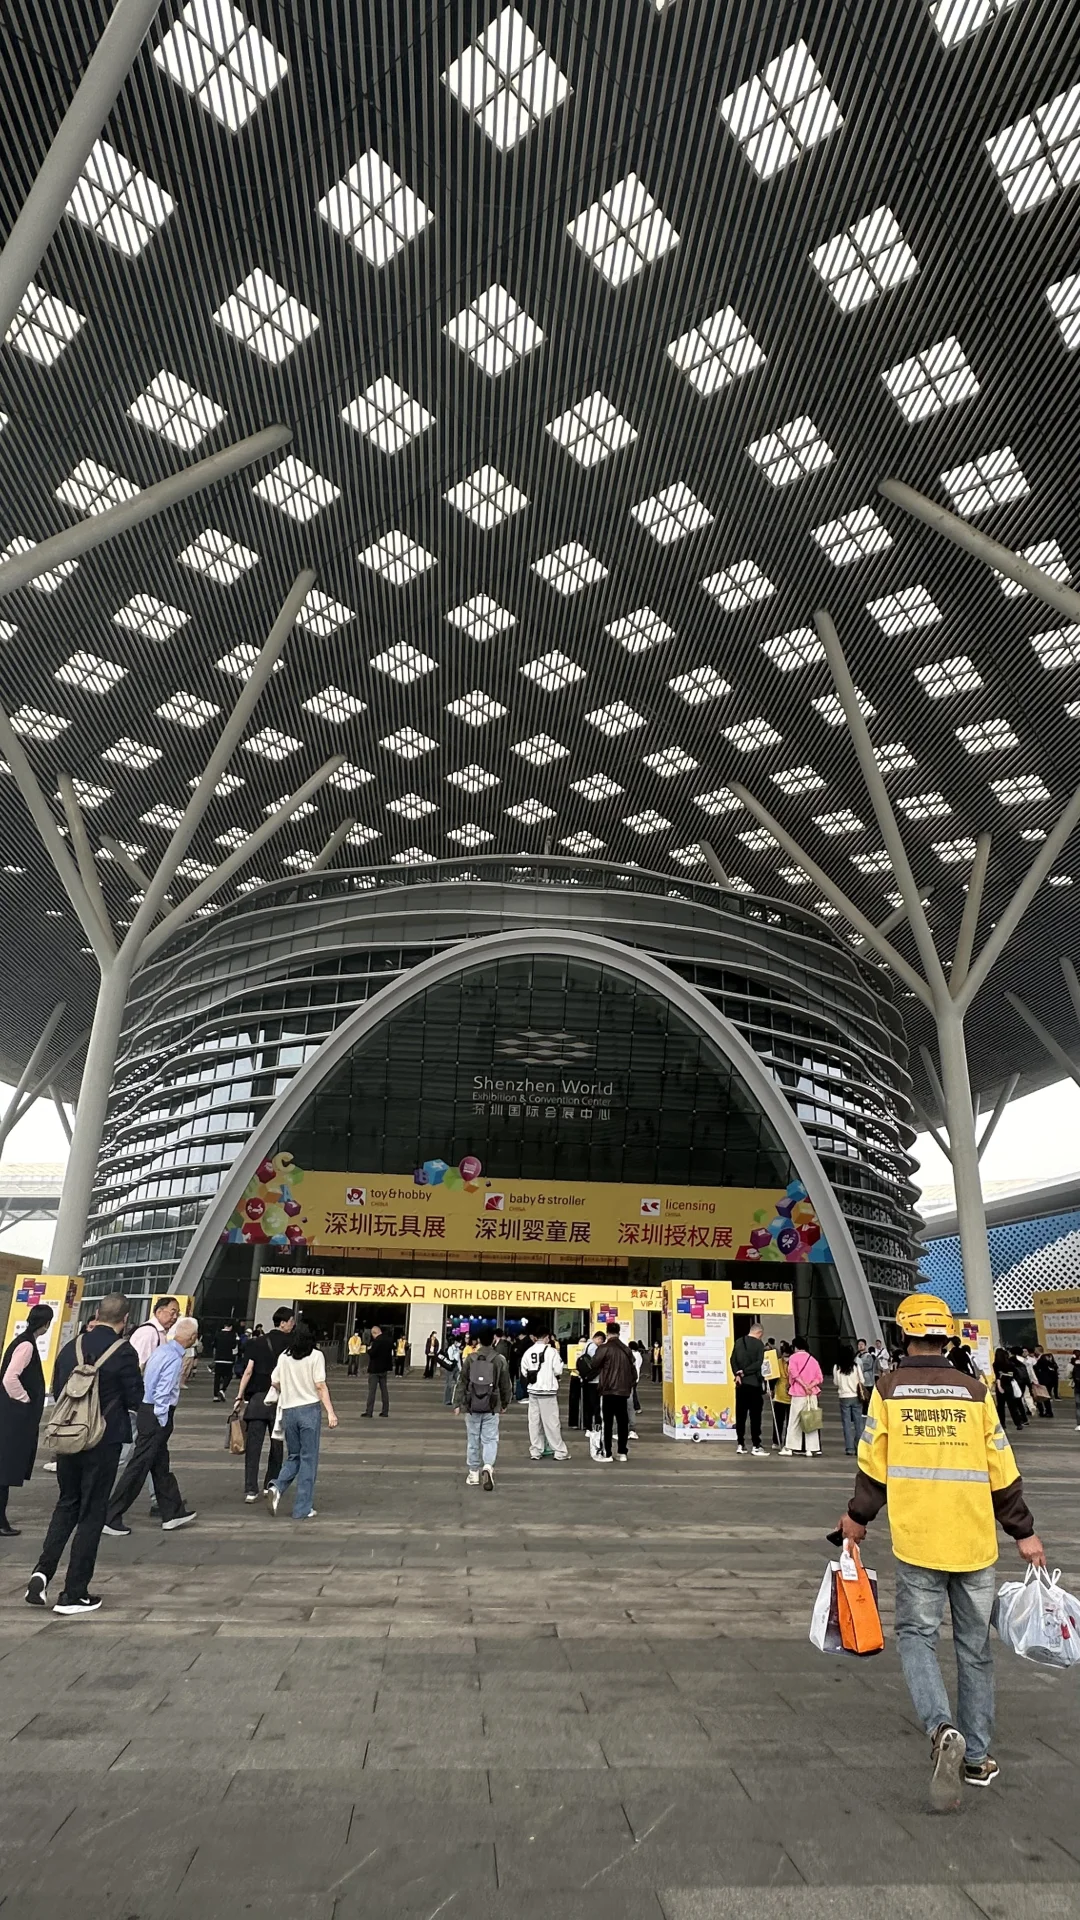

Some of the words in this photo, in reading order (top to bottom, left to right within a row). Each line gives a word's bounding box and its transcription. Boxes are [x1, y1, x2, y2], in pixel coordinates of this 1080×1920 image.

[473, 1075, 555, 1093] Shenzhen
[562, 1079, 613, 1096] World
[472, 1091, 517, 1102] Exhibition
[519, 1093, 527, 1102] &
[528, 1094, 580, 1105] Convention
[581, 1096, 611, 1106] Center
[472, 1103, 611, 1121] 深圳国际会展中心
[665, 1199, 716, 1214] licensing
[325, 1212, 446, 1238] 深圳玩具展
[475, 1217, 591, 1243] 深圳婴童展
[618, 1222, 733, 1248] 深圳授权展
[287, 1267, 325, 1275] LOBBY(E)
[305, 1281, 425, 1299] 北登录大厅观众入口
[433, 1287, 473, 1300] NORTH
[476, 1289, 513, 1301] LOBBY
[516, 1290, 576, 1303] ENTRANCE
[640, 1300, 653, 1308] VIP
[752, 1298, 776, 1308] EXIT
[908, 1387, 954, 1395] MEITUAN
[900, 1408, 967, 1423] 买咖啡奶茶
[902, 1425, 957, 1437] 上美团外卖
